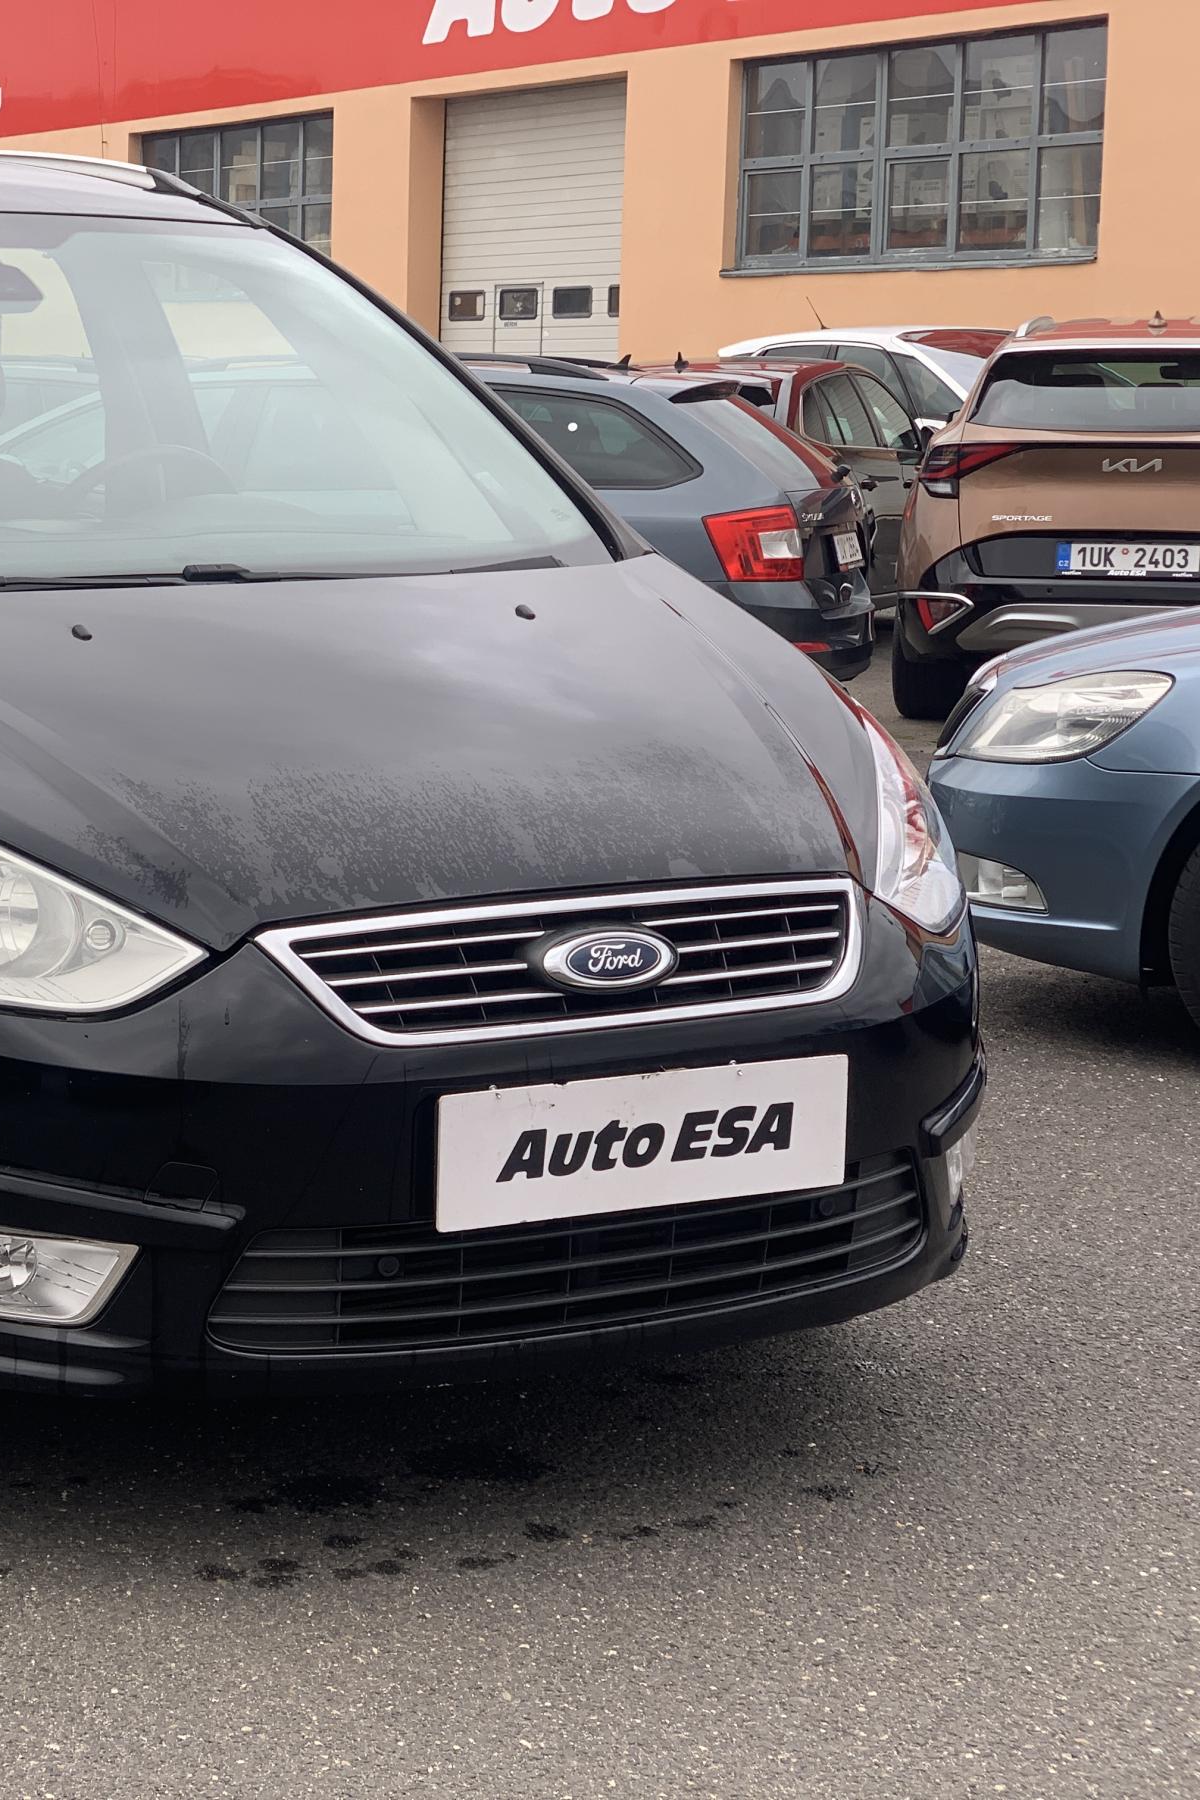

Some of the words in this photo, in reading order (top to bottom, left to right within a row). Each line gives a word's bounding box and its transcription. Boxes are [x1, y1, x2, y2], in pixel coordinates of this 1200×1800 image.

[1102, 458, 1163, 473] KIA
[991, 514, 1054, 522] SPORTAGE
[1058, 560, 1069, 568] CZ
[1077, 546, 1116, 568] 1UK
[1134, 548, 1190, 569] 2403
[588, 943, 644, 973] Ford
[496, 1119, 666, 1183] Auto
[670, 1102, 794, 1162] ESA
